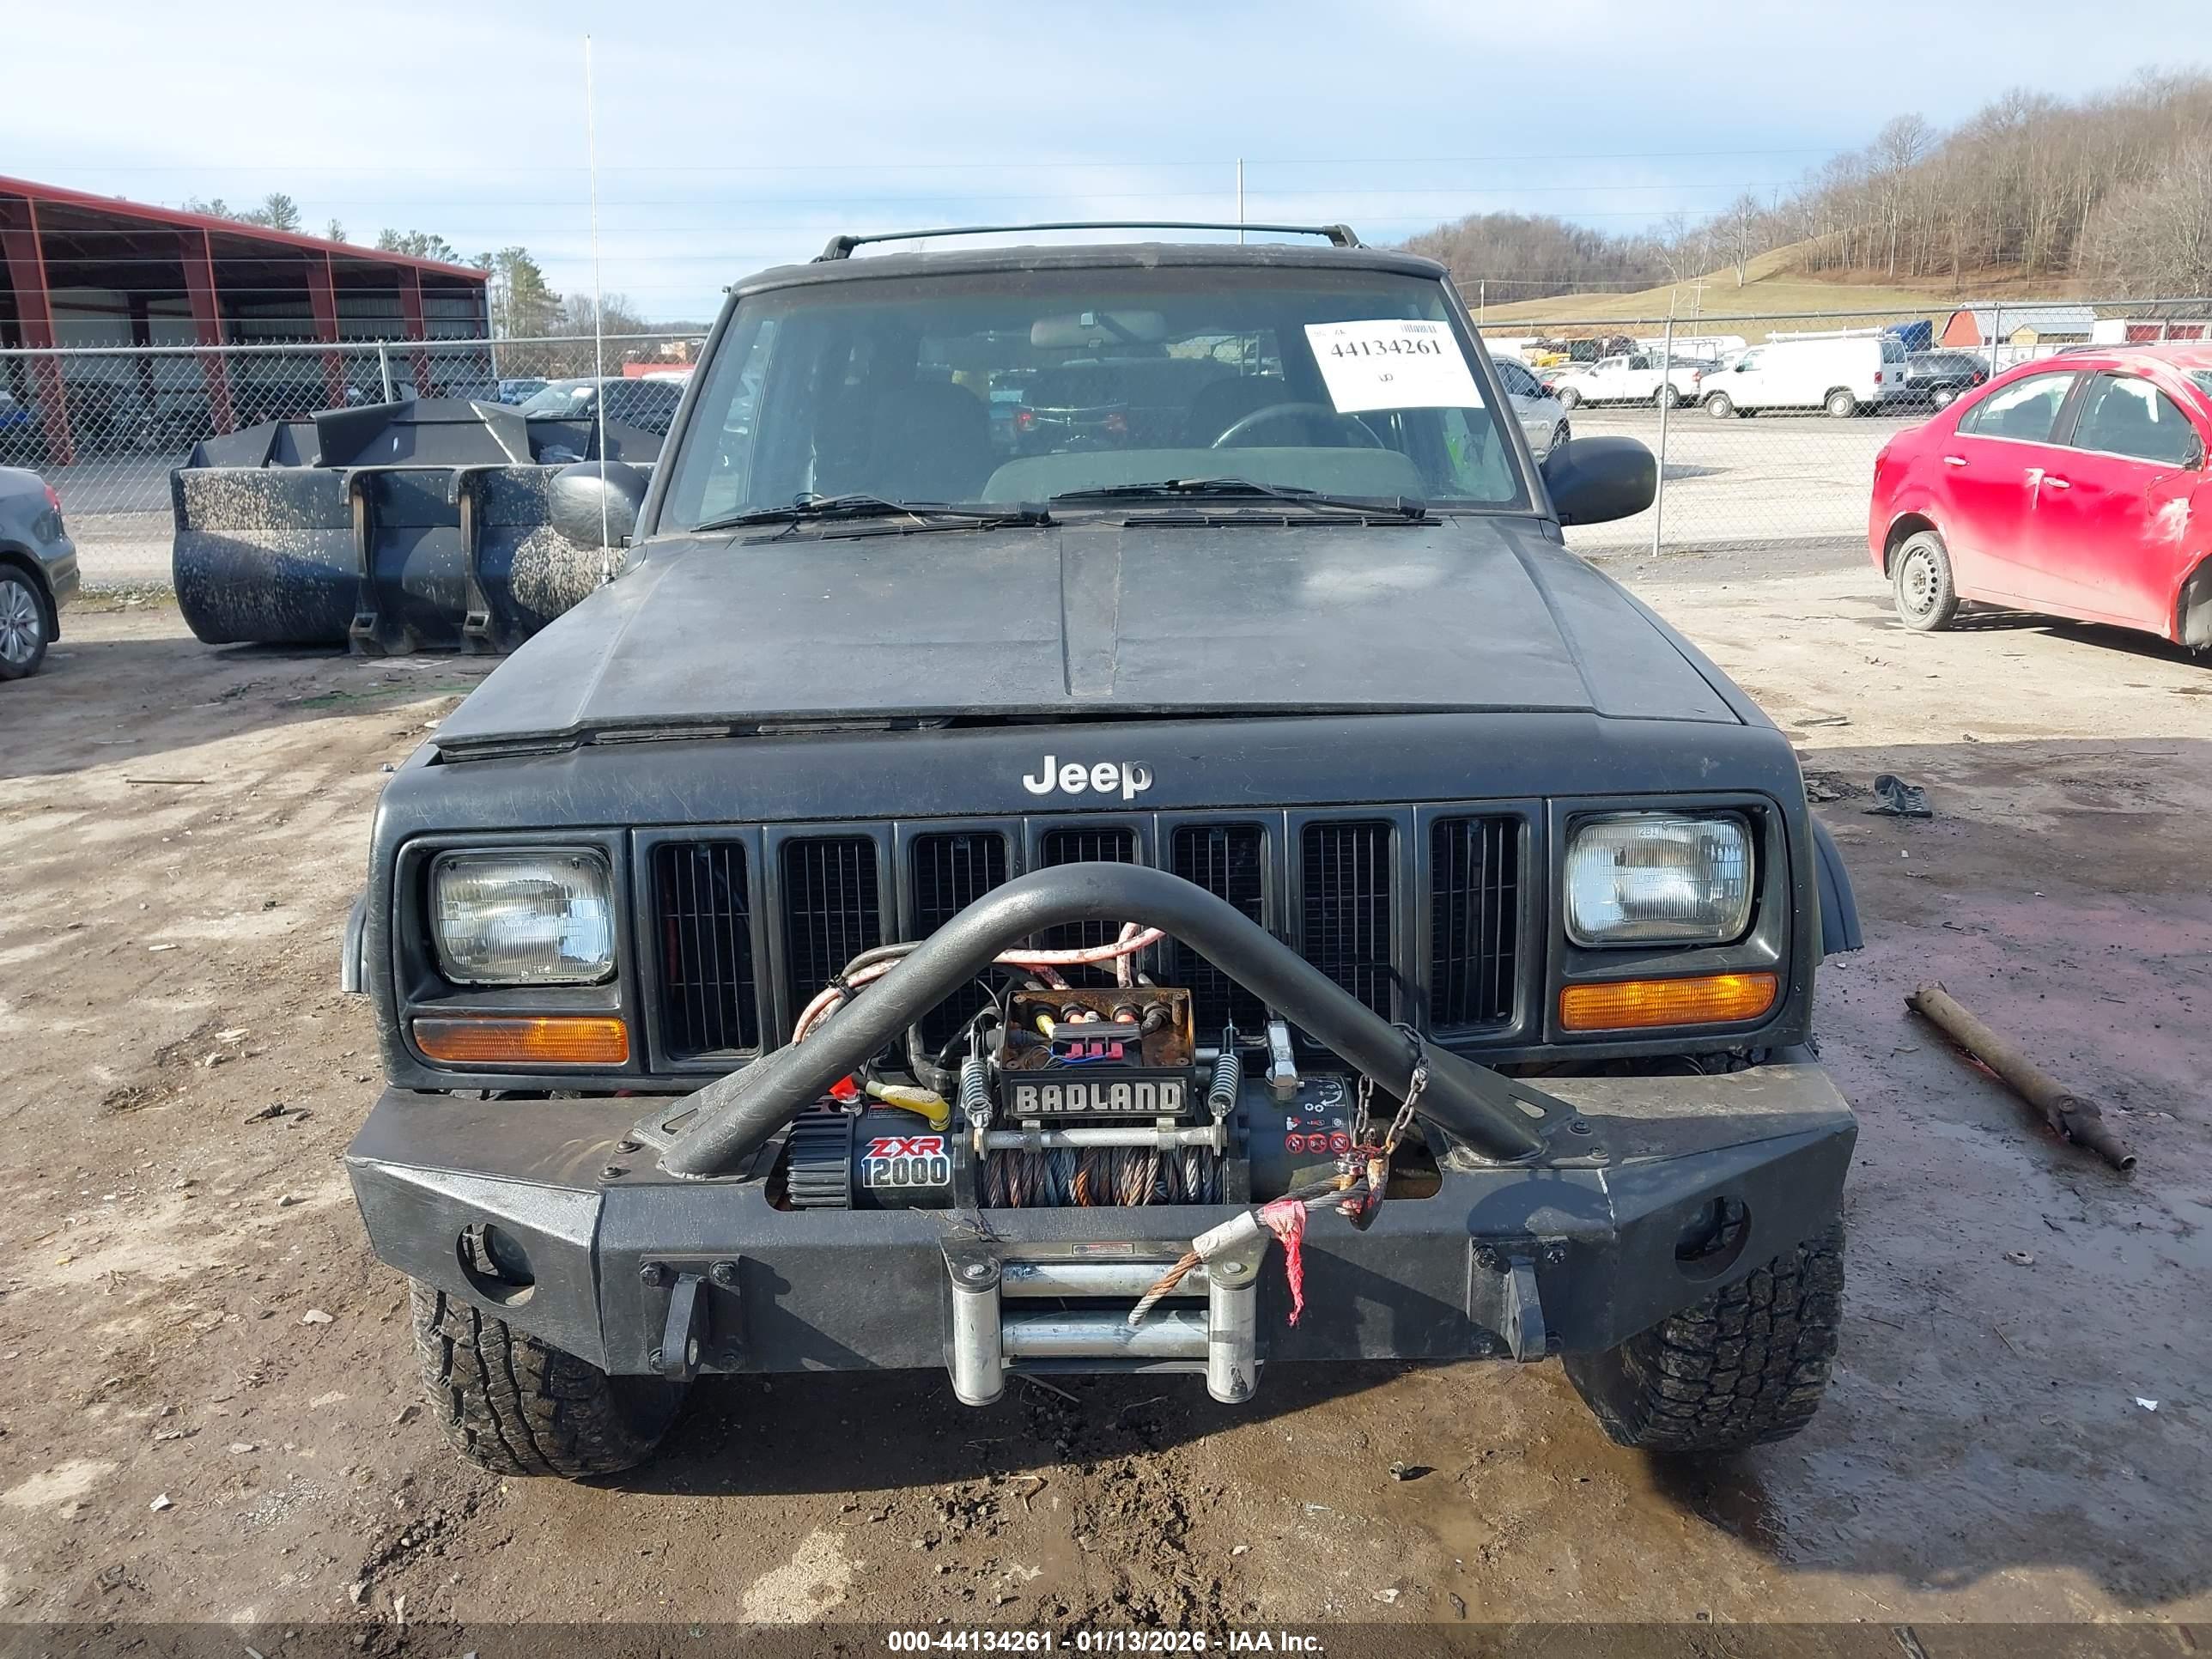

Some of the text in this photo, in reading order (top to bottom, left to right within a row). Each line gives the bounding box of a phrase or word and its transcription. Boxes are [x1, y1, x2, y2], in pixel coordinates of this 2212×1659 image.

[1331, 339, 1442, 357] 44134261
[1023, 755, 1153, 799] Jeep
[1016, 1083, 1181, 1111] BADLAND
[866, 1137, 943, 1158] ZXR
[862, 1158, 948, 1186] 12000
